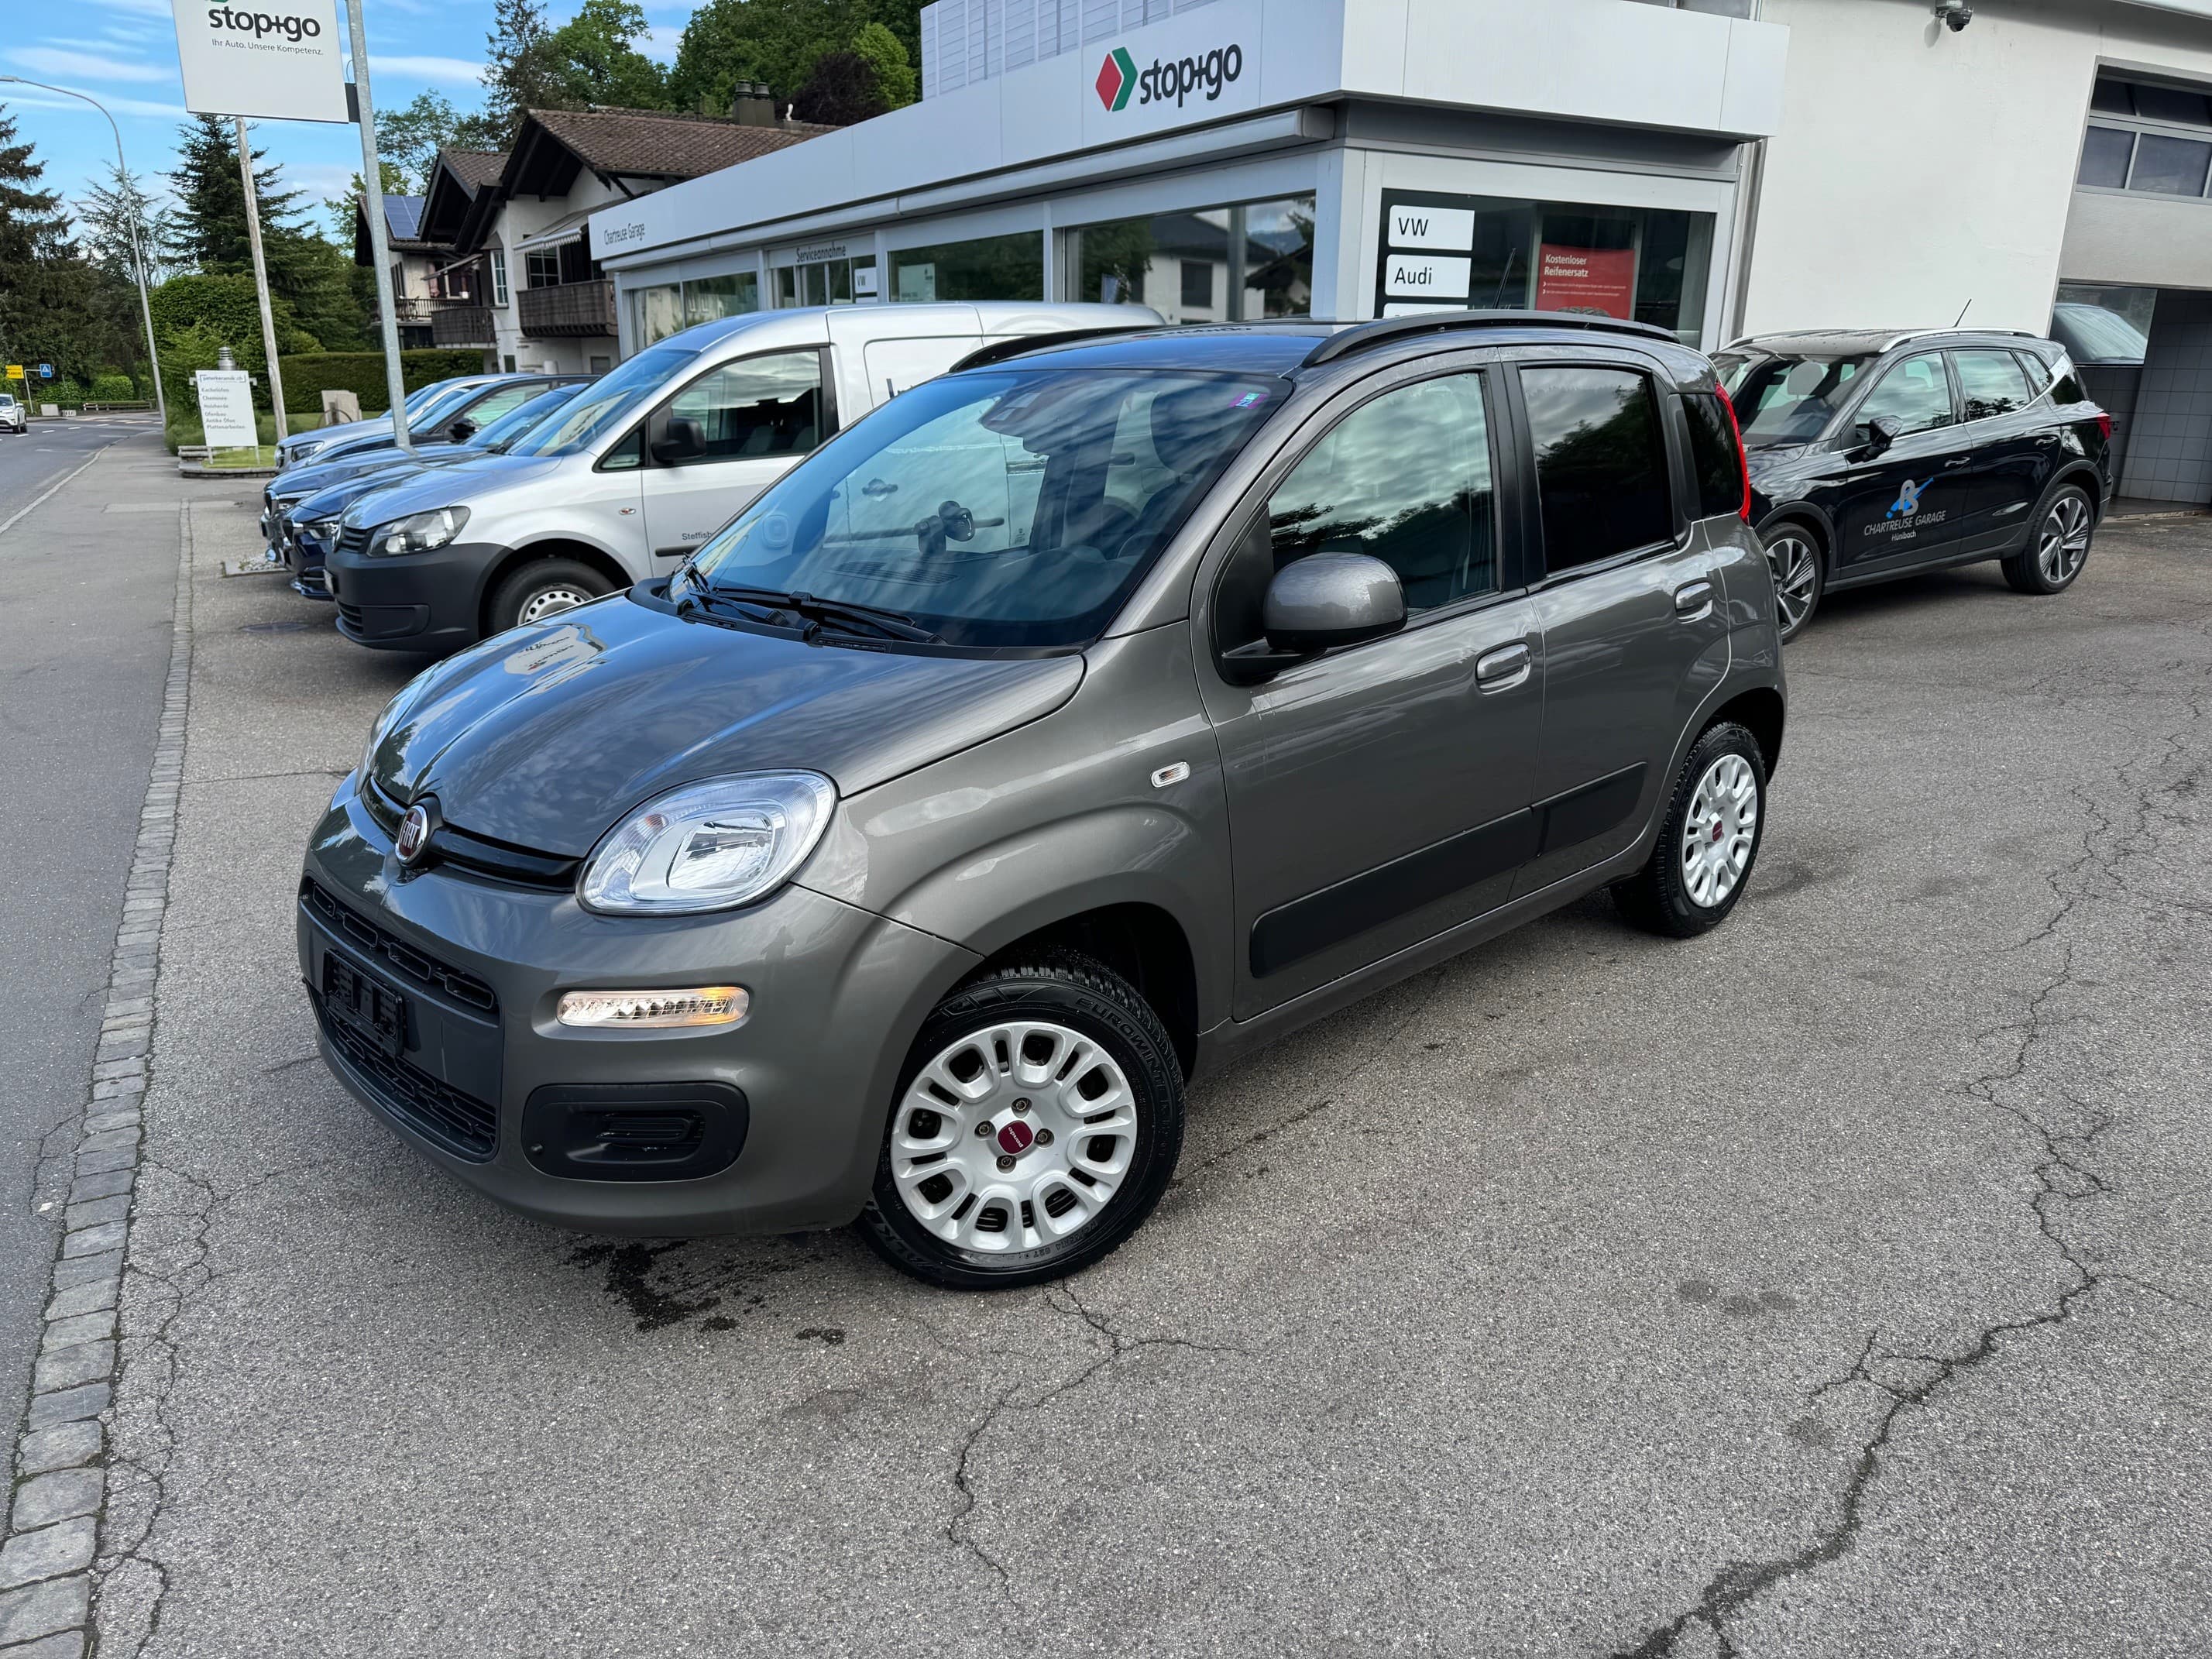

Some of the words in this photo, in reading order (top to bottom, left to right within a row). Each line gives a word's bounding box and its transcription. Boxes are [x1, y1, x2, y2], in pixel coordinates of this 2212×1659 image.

[208, 6, 321, 42] stop+go
[225, 40, 246, 49] Auto.
[248, 42, 276, 51] Unsere
[276, 44, 325, 55] Kompetenz.
[1140, 44, 1242, 108] stop+go
[1398, 217, 1429, 236] VW
[1545, 254, 1588, 265] Kostenloser
[1394, 266, 1433, 285] Audi
[1544, 266, 1589, 277] Reifenersatz
[1864, 517, 1914, 536] CHARTREUSE
[1915, 510, 1946, 527] GARAGE
[1008, 1127, 1024, 1148] panda
